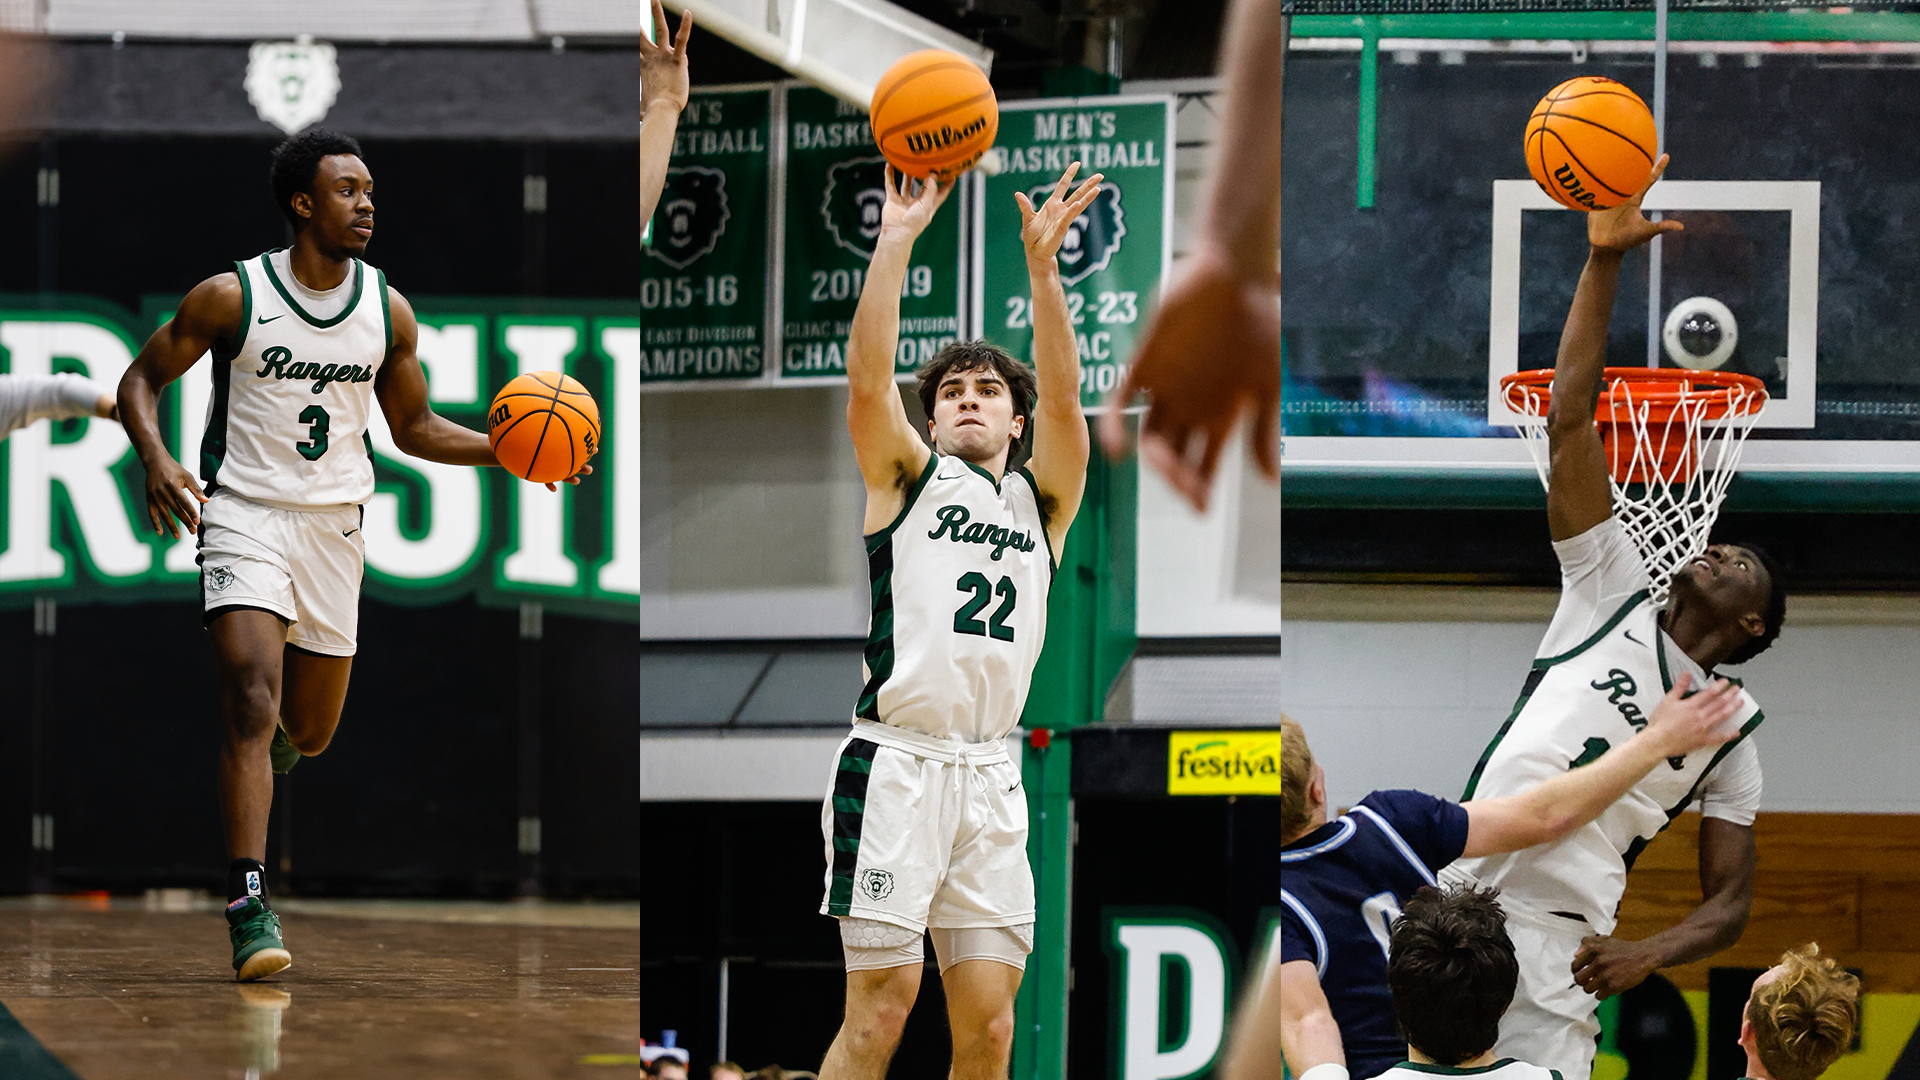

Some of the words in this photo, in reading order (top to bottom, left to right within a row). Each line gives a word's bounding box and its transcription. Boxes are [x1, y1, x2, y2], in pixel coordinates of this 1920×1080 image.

[671, 127, 764, 156] ETBALL
[1034, 112, 1116, 140] MEN'S
[256, 345, 373, 394] Rangers
[296, 404, 330, 461] 3
[953, 571, 1017, 643] 22
[1177, 746, 1281, 779] festiva
